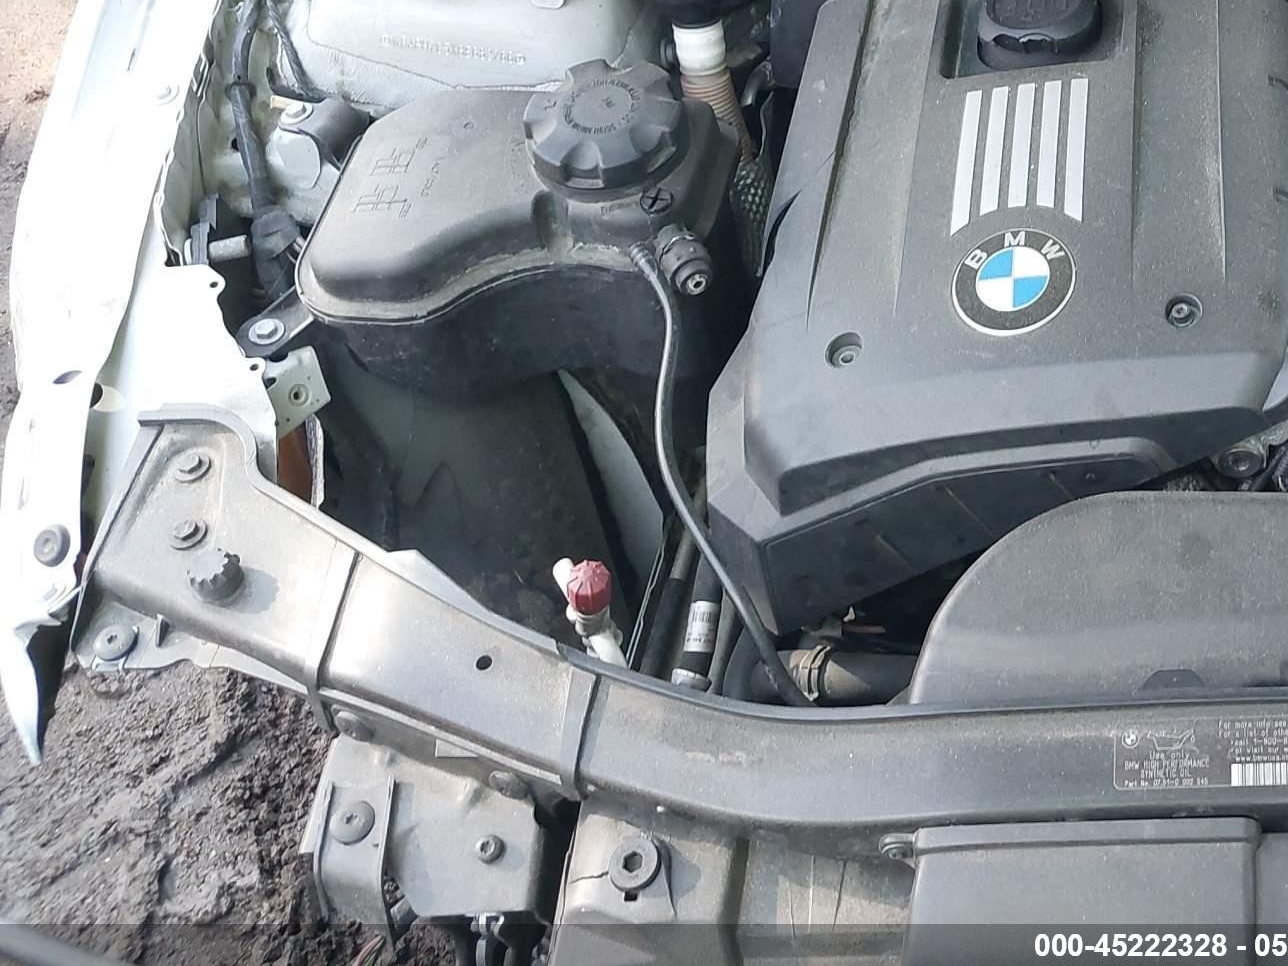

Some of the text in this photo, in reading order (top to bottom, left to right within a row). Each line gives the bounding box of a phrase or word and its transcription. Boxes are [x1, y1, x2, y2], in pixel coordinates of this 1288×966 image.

[964, 231, 1066, 270] BMW
[1149, 749, 1190, 762] Use only
[1124, 756, 1209, 771] BMW HIGH PERFORMANCE
[1140, 768, 1177, 779] SYNTHETIC
